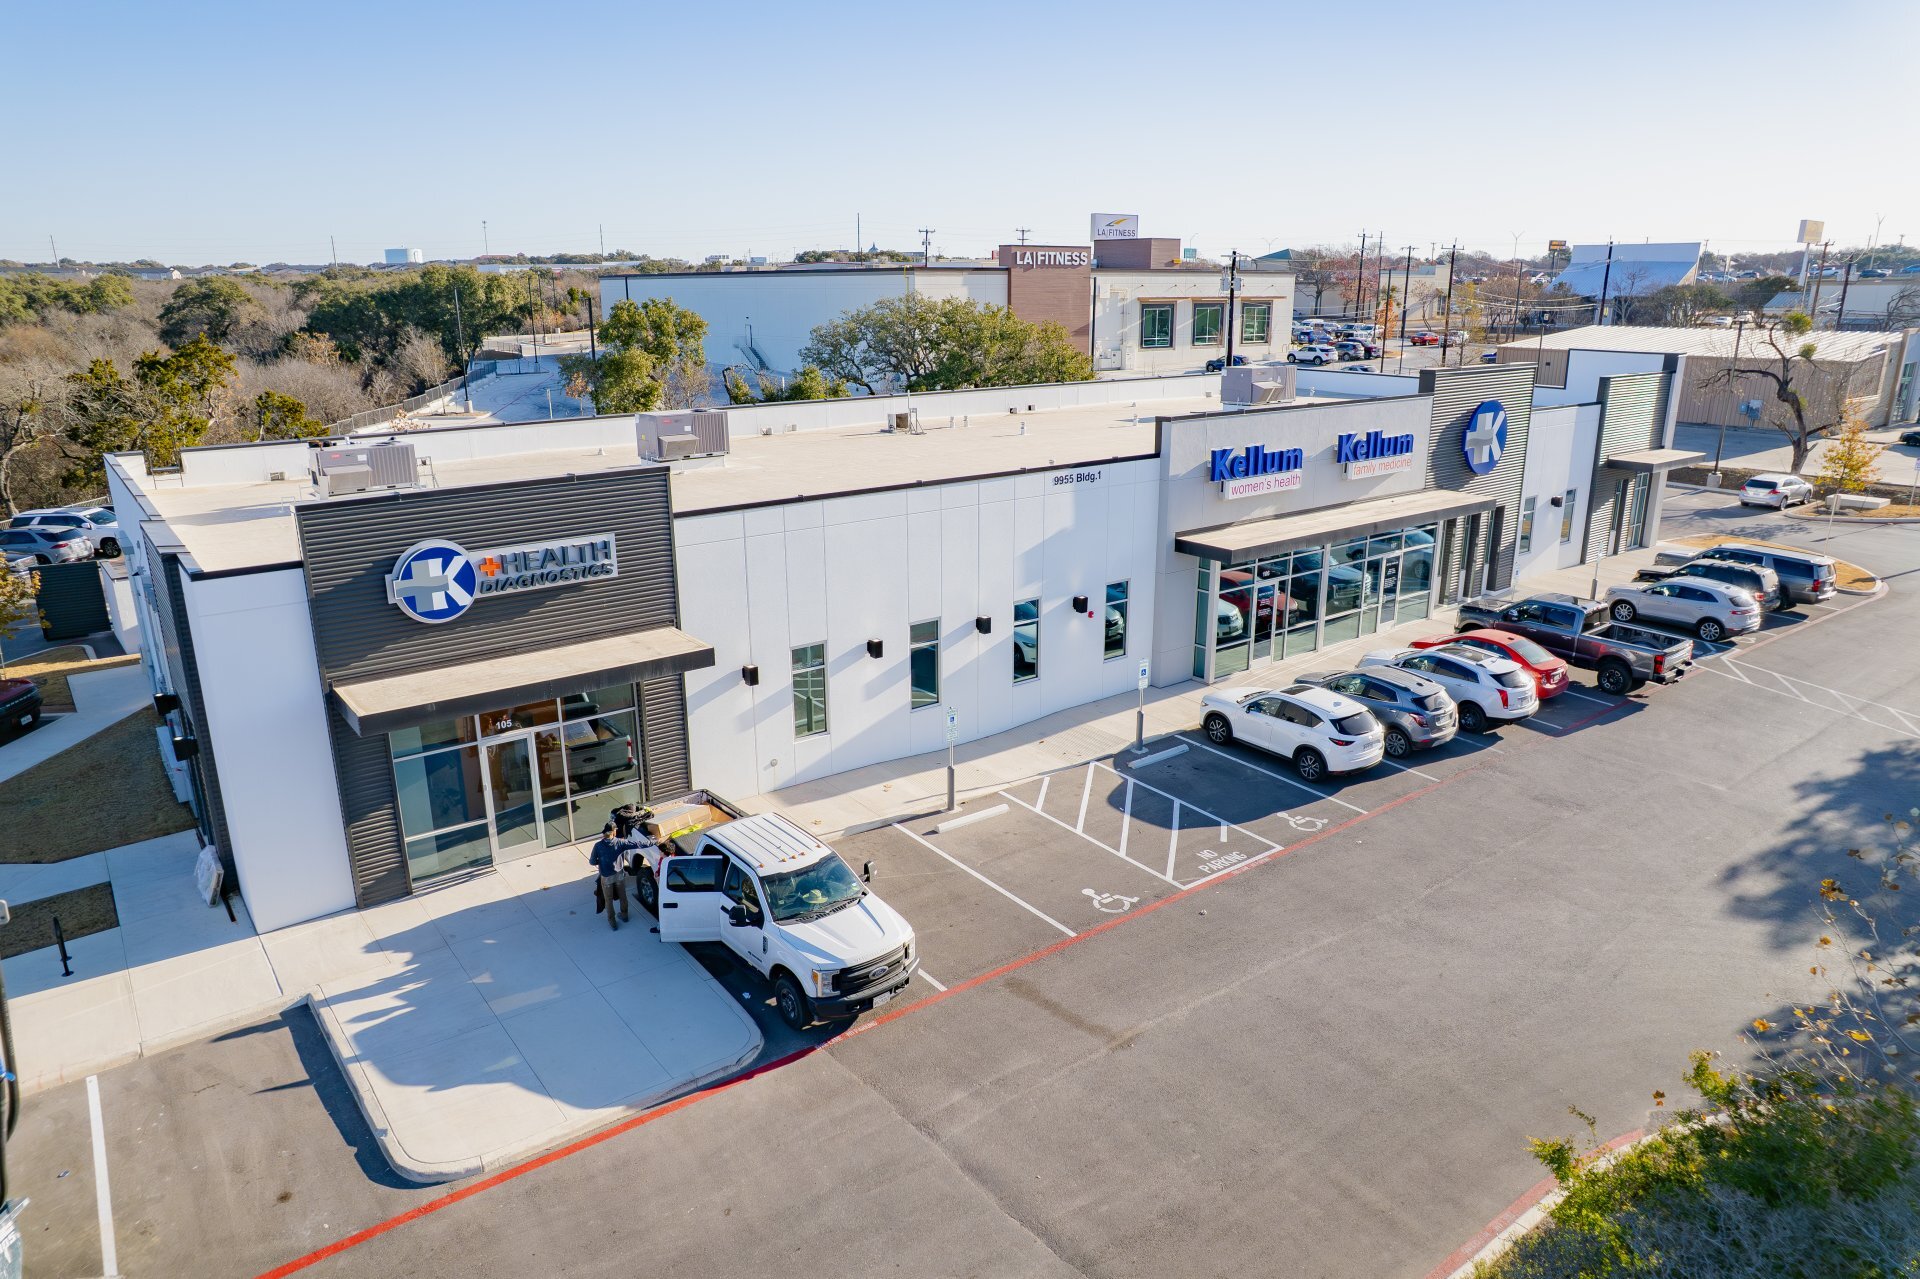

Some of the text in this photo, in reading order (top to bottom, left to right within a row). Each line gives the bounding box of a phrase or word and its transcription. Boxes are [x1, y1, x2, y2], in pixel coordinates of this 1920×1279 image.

[1336, 429, 1415, 463] Kellum
[1210, 444, 1303, 482] Kellum
[1353, 457, 1411, 476] family medicine
[1053, 473, 1074, 485] 9955
[1231, 473, 1301, 496] women's health
[500, 540, 612, 575] HEALTH
[480, 563, 614, 595] DIAGNOSTICS
[496, 719, 513, 730] 105
[1196, 849, 1218, 860] NO
[1198, 851, 1248, 873] PARKING
